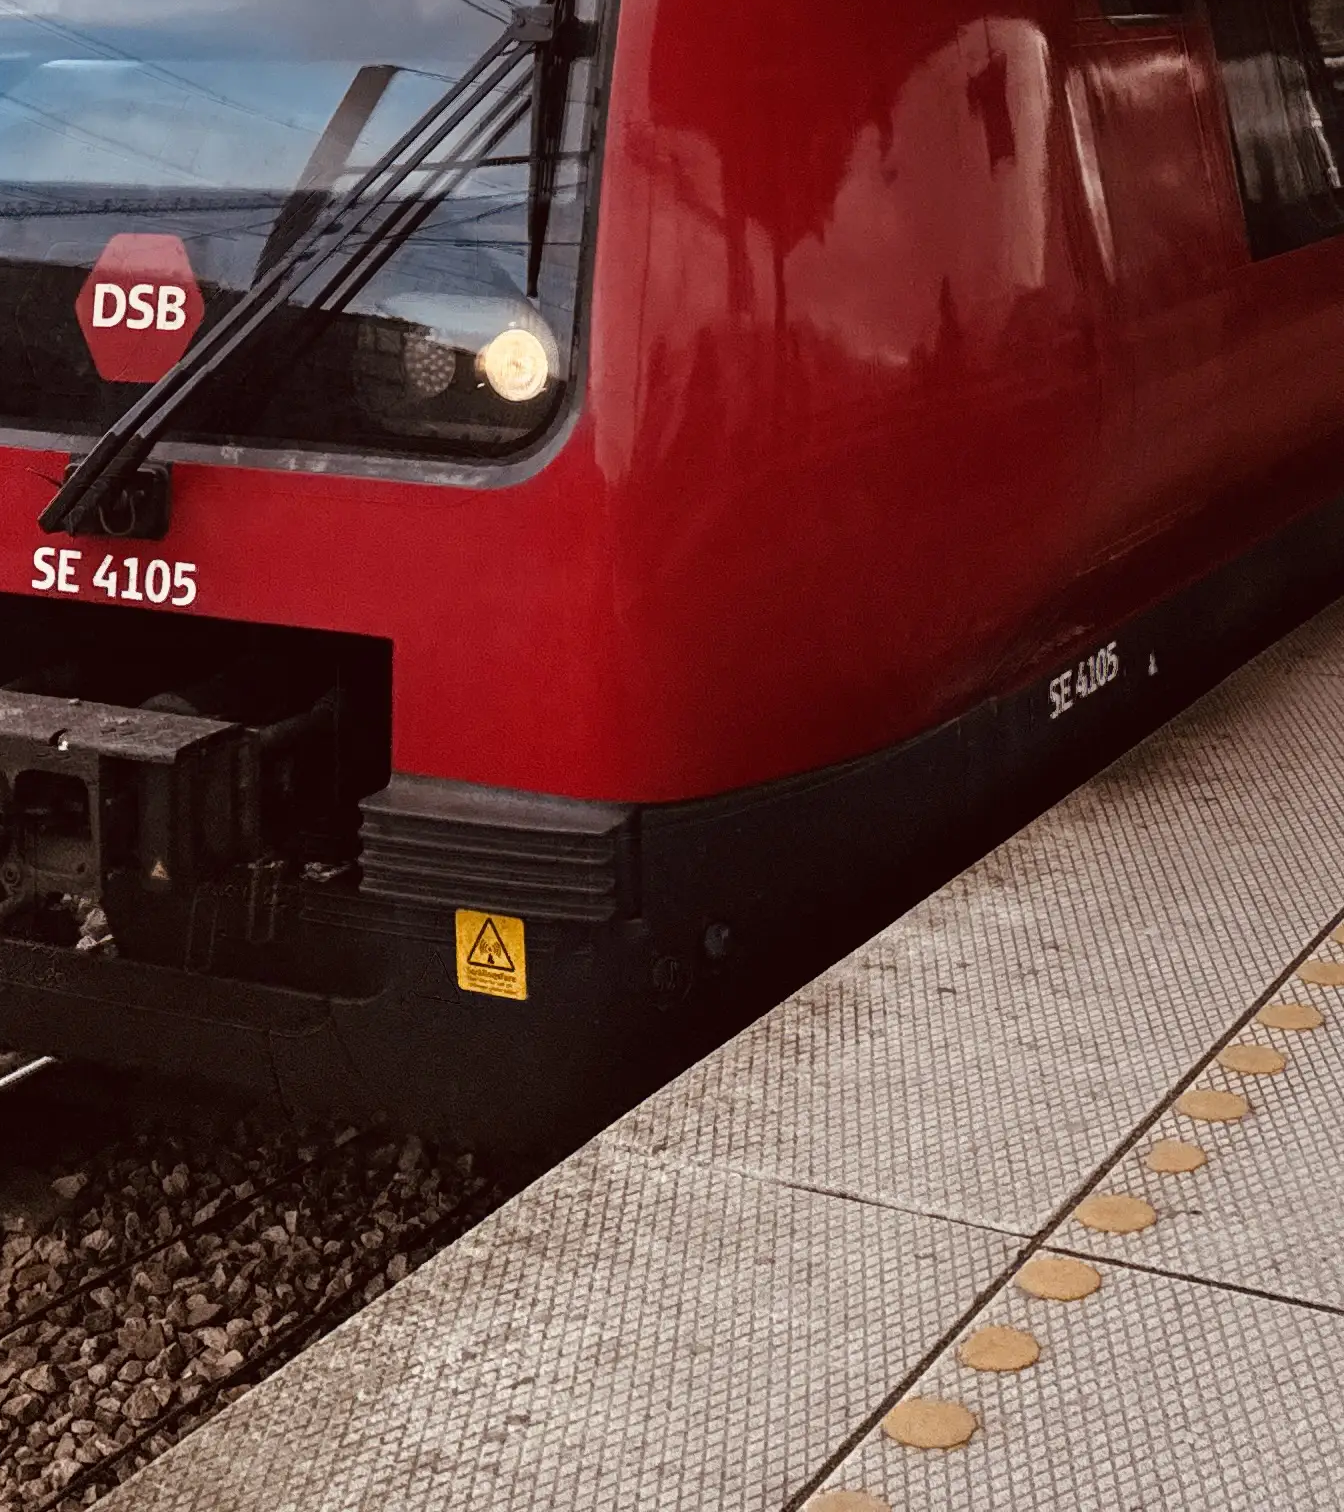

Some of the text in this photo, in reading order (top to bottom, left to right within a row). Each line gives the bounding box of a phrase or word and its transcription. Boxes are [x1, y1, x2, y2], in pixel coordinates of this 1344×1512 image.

[92, 283, 186, 331] DSB
[31, 546, 197, 607] SE 4105
[1049, 669, 1074, 719] SE
[1076, 640, 1119, 699] 4105
